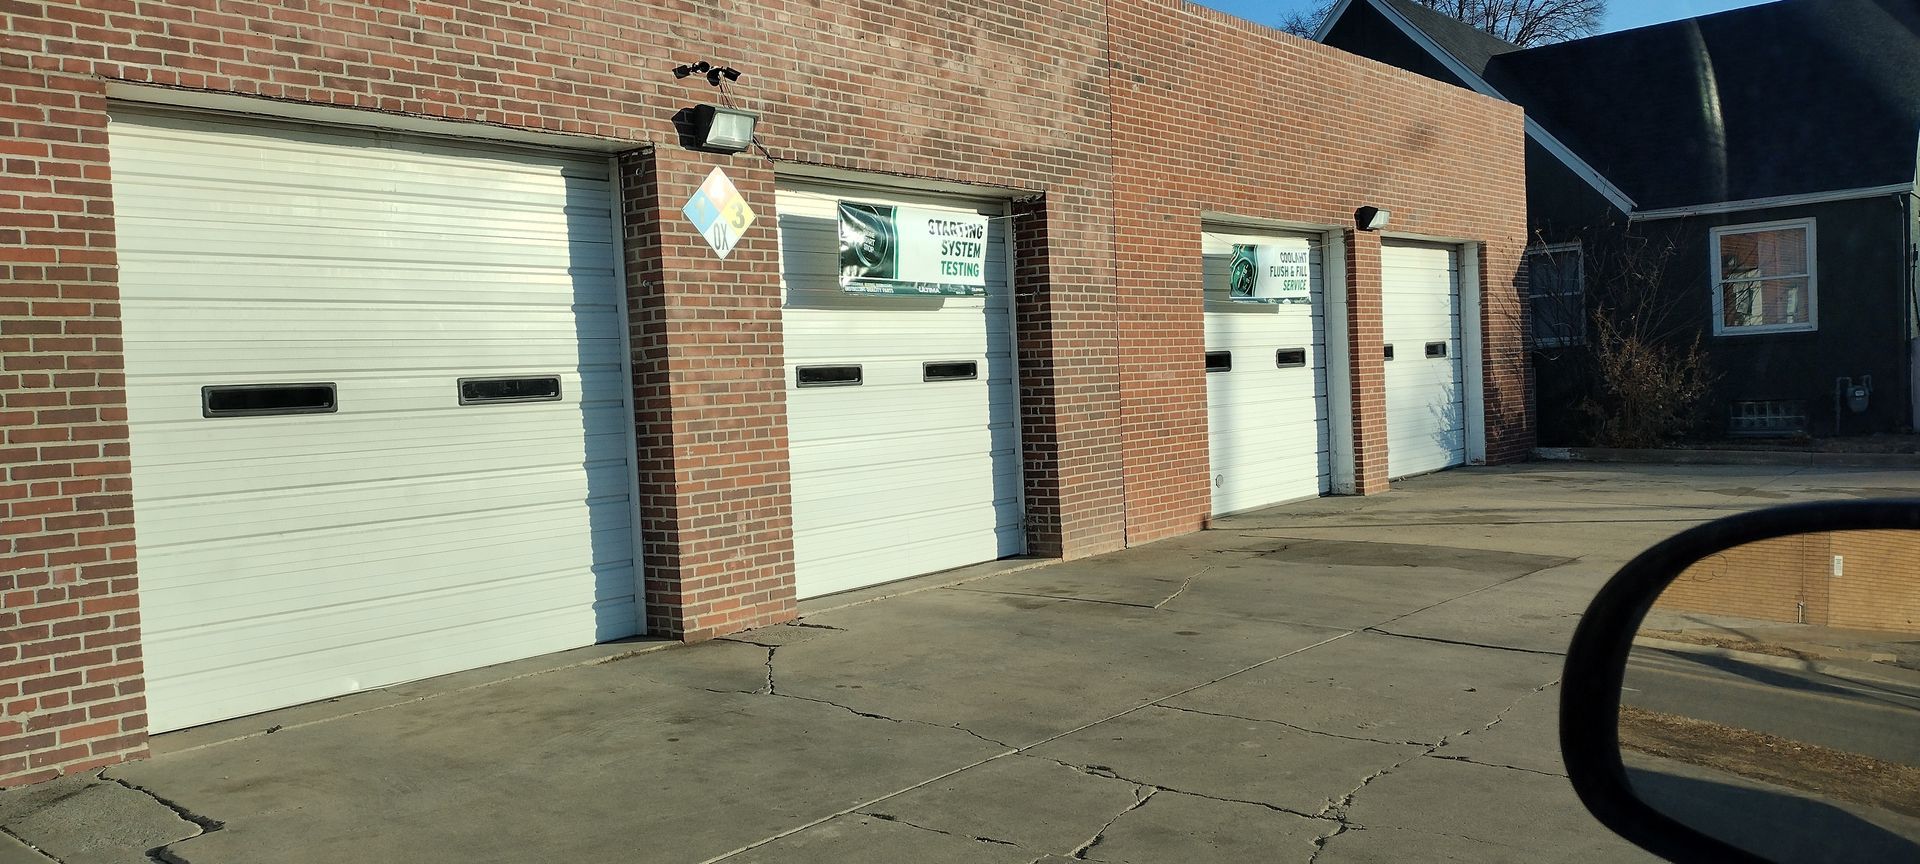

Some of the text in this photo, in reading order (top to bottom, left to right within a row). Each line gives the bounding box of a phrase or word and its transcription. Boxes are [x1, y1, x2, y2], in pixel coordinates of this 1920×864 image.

[695, 197, 705, 225] 1
[731, 203, 745, 229] 3
[713, 222, 729, 251] OX
[928, 218, 983, 239] STARTING
[941, 240, 981, 258] SYSTEM
[1280, 252, 1307, 264] COOLANT
[941, 260, 980, 277] TESTING
[1270, 265, 1308, 277] FLUSH & FILL
[1283, 279, 1306, 291] SERVICE
